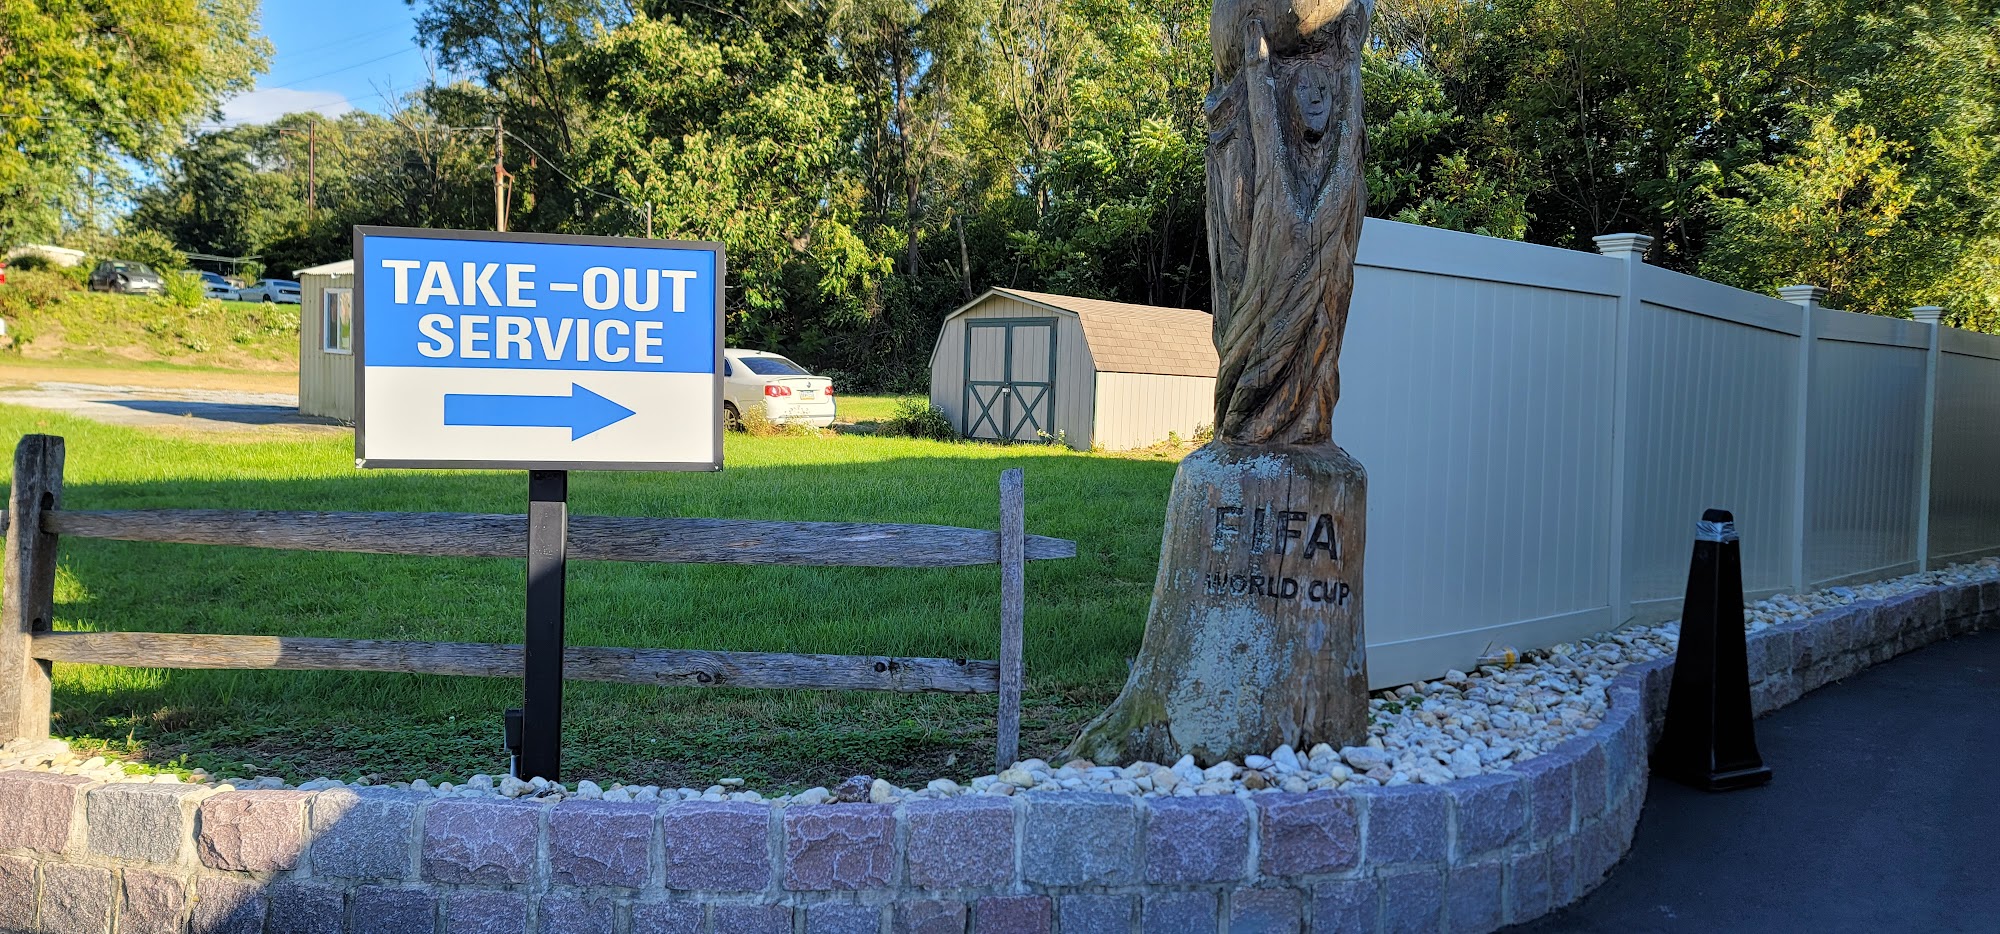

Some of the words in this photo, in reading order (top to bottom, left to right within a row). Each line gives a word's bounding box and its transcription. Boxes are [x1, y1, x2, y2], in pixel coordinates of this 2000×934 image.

[416, 313, 664, 364] SERVICE
[1214, 506, 1338, 561] FIFA
[1206, 571, 1299, 600] WORLD
[1308, 579, 1351, 606] CUP
